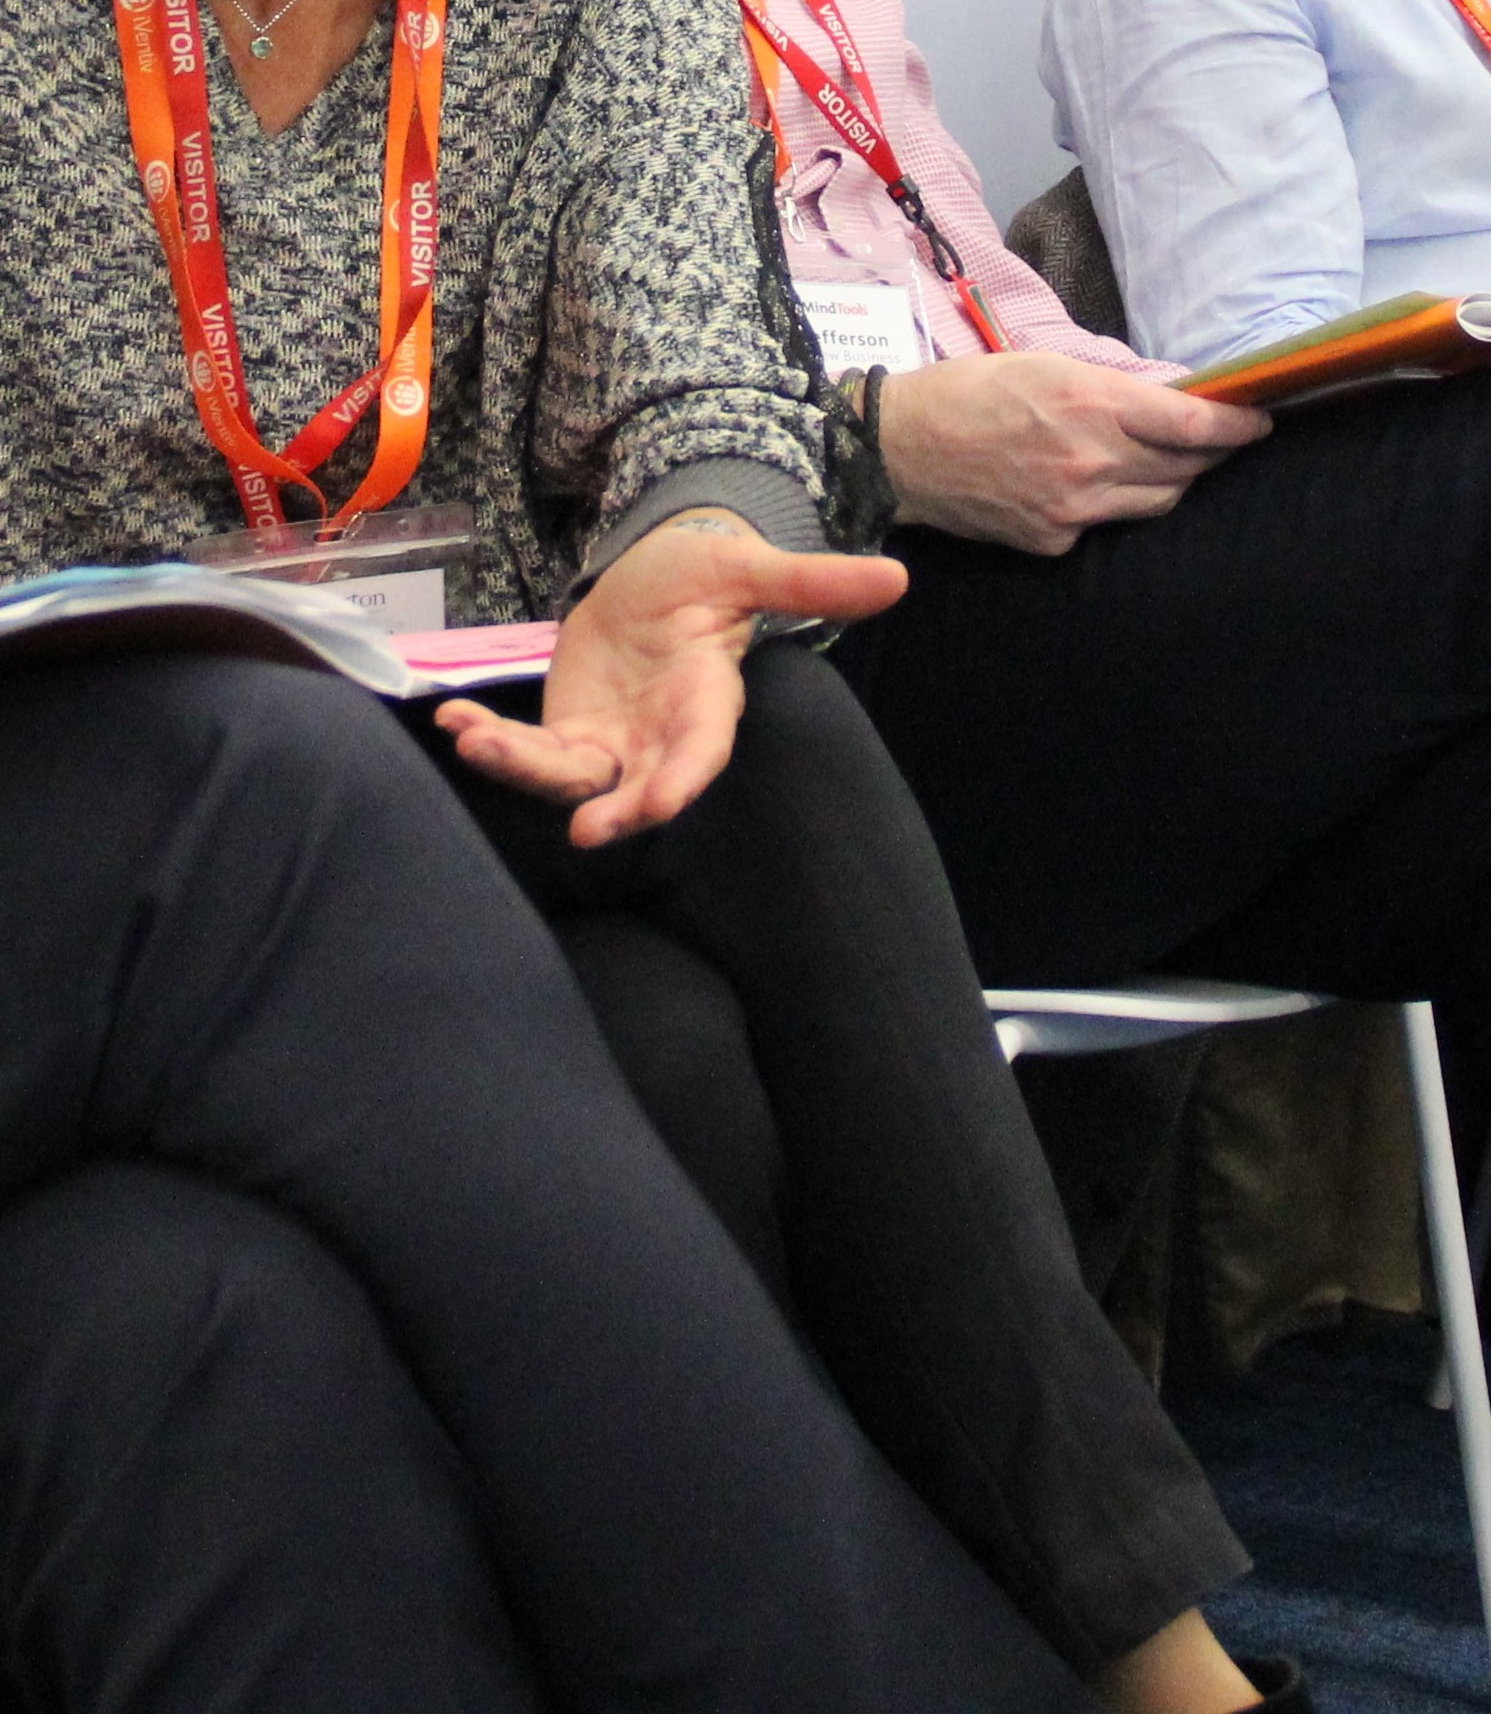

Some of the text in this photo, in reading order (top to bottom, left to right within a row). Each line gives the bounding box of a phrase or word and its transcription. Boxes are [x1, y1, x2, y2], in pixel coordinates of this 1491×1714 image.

[132, 15, 153, 73] iVentiv
[818, 3, 864, 74] VISITOR
[818, 83, 877, 155] VISITOR
[181, 130, 211, 243] VISITOR
[411, 179, 433, 288] VISITOR
[818, 329, 889, 347] fferson
